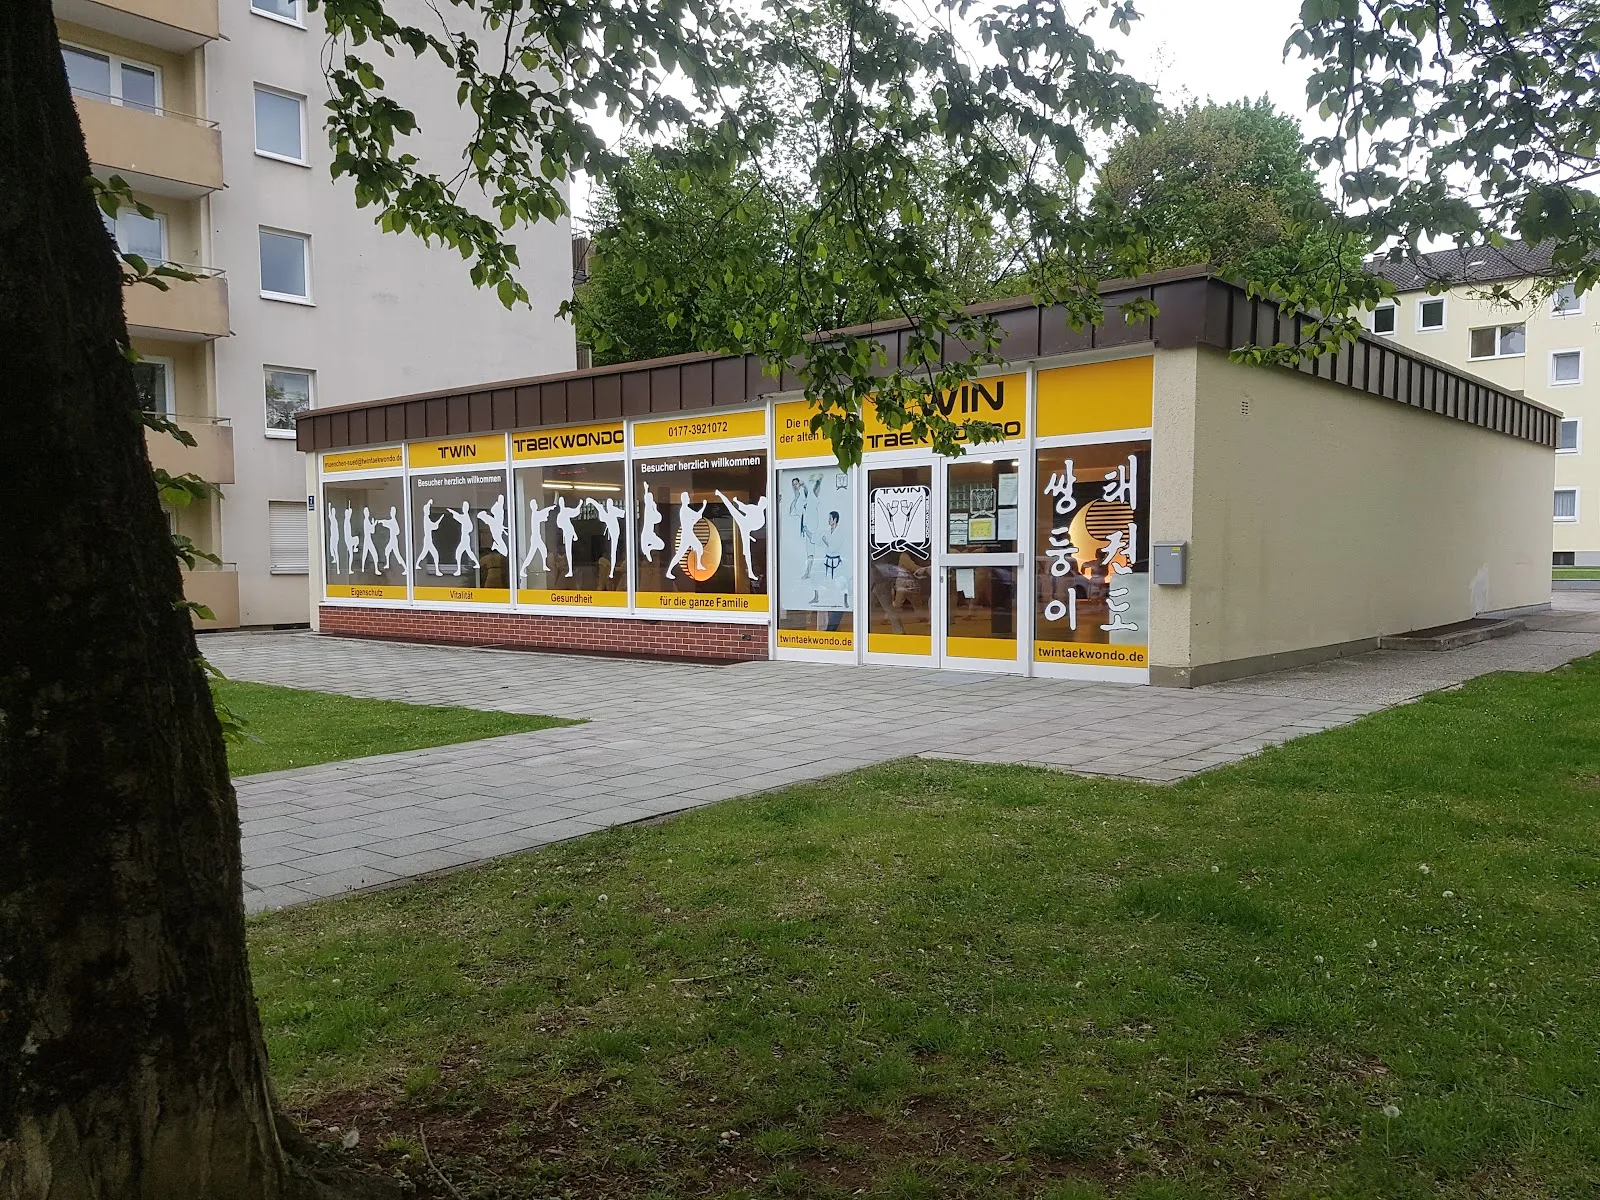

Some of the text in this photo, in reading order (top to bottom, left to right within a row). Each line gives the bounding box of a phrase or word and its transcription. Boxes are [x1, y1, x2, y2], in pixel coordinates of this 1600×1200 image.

[893, 381, 1004, 417] WIN
[668, 422, 728, 437] 0177-3921072
[786, 418, 801, 429] Die
[780, 432, 794, 443] der
[797, 432, 819, 442] alten
[438, 444, 476, 459] TWIN
[641, 456, 761, 473] Besucher herzlich willkommen
[417, 475, 501, 487] Besucher herzlich willkommen
[880, 486, 921, 494] TWIN
[351, 587, 383, 597] Eigenschutz
[450, 590, 473, 600] Vitalität
[550, 593, 593, 604] Gesundheit
[660, 596, 749, 609] für die ganze Familie
[780, 635, 852, 647] twintaekwondo.de
[1038, 647, 1144, 662] twintaekwondo.de
